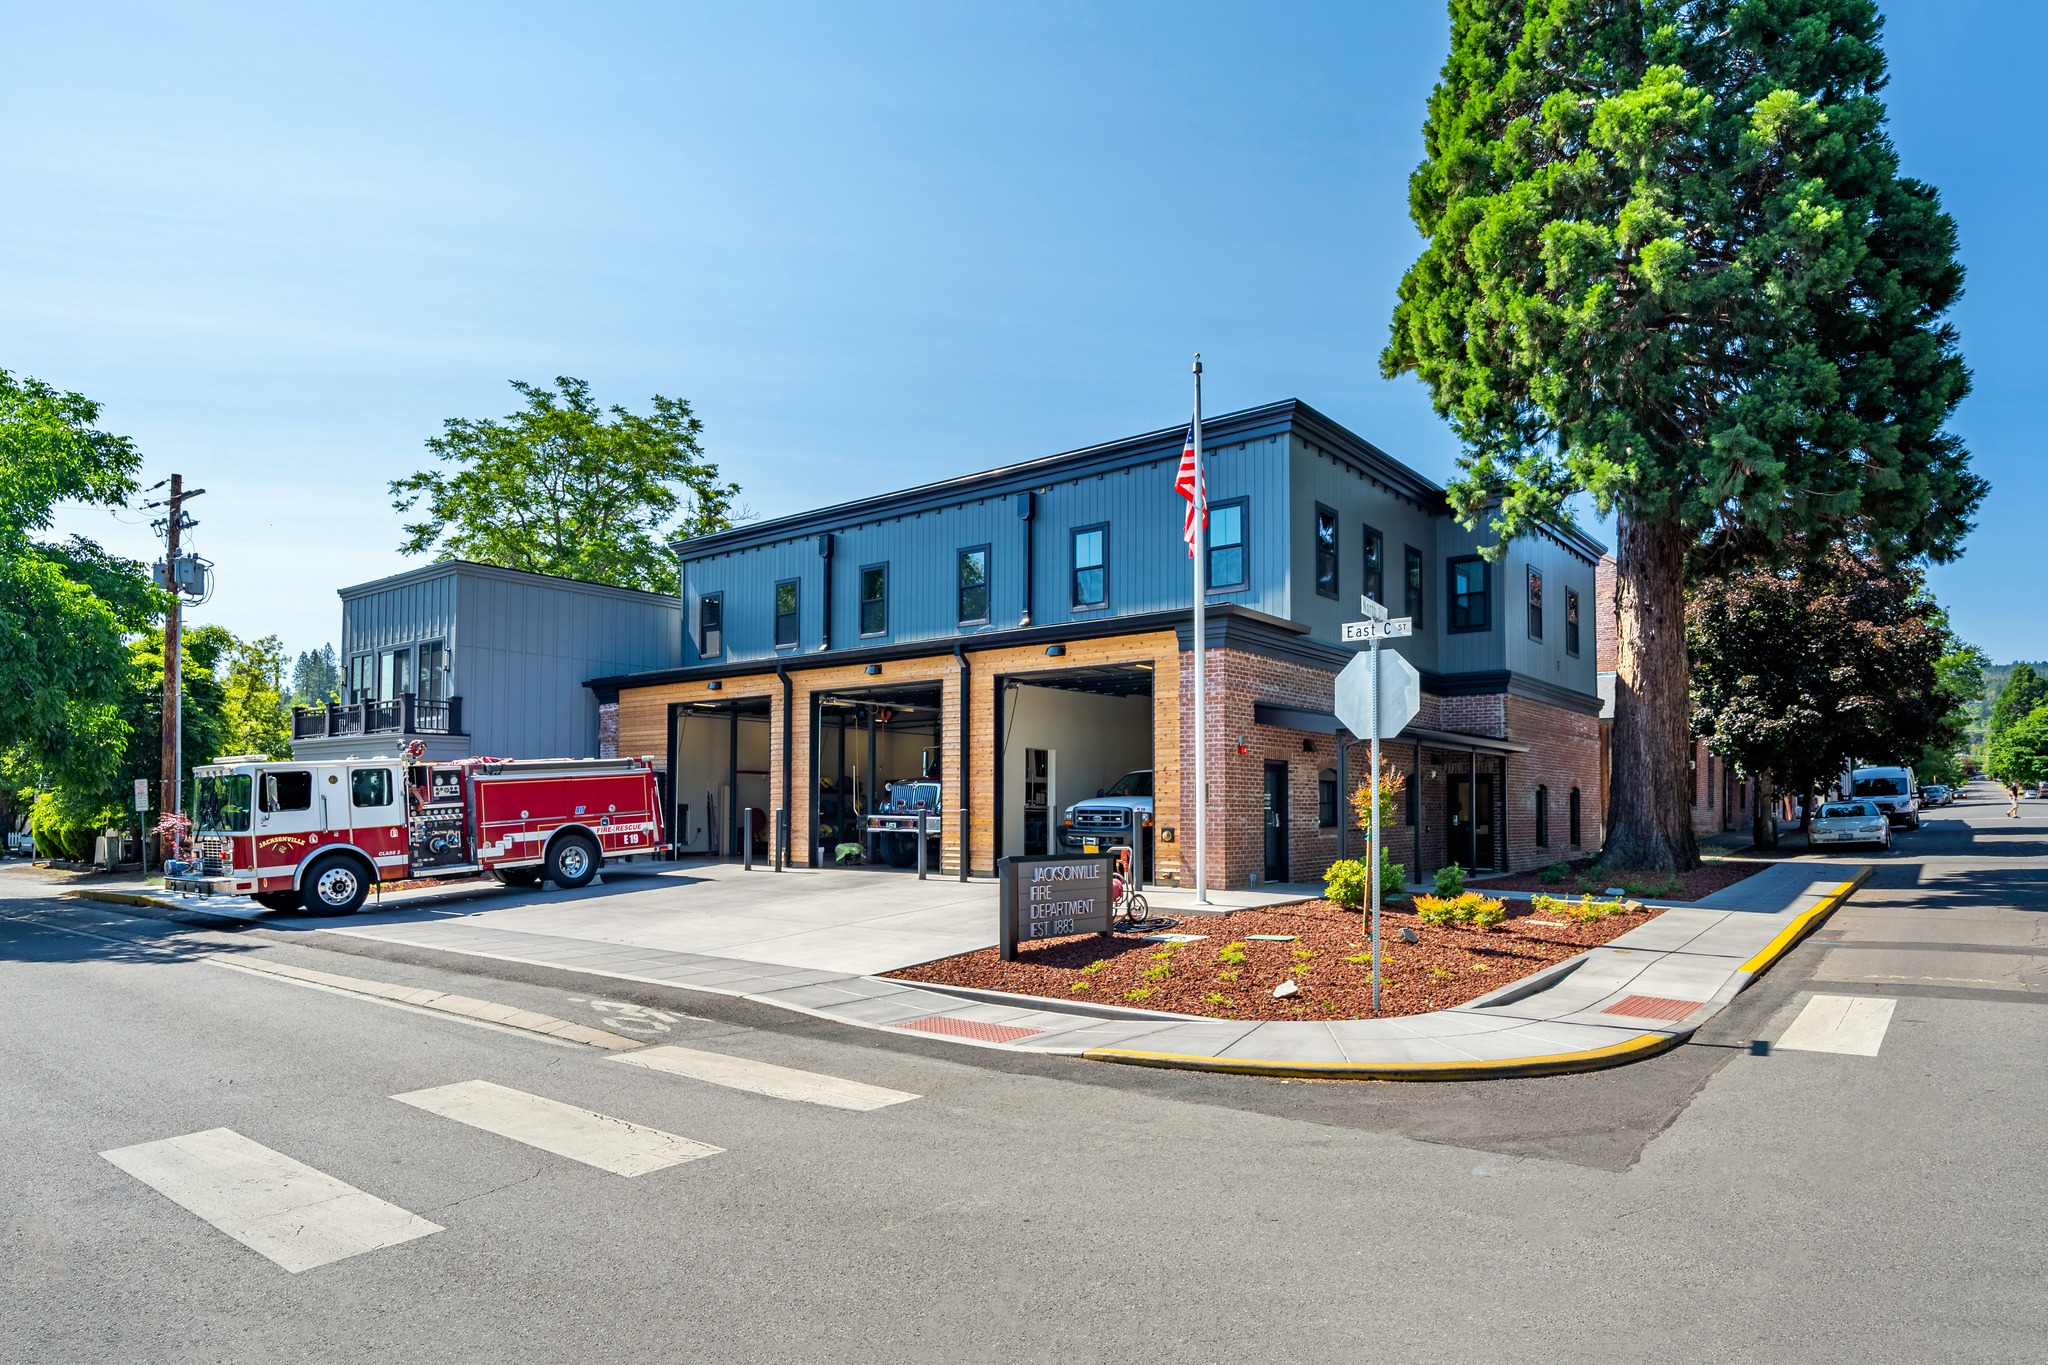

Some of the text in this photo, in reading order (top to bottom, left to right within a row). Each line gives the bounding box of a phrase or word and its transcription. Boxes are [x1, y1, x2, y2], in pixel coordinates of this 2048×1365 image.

[1347, 624, 1375, 638] East
[1384, 622, 1391, 635] C
[259, 836, 306, 848] JACKSONVILLE
[1032, 864, 1100, 883] JACKSONVILLE
[1030, 885, 1052, 900] FIRE
[1030, 899, 1095, 919] DEPARTMENT
[1053, 918, 1075, 935] 1883
